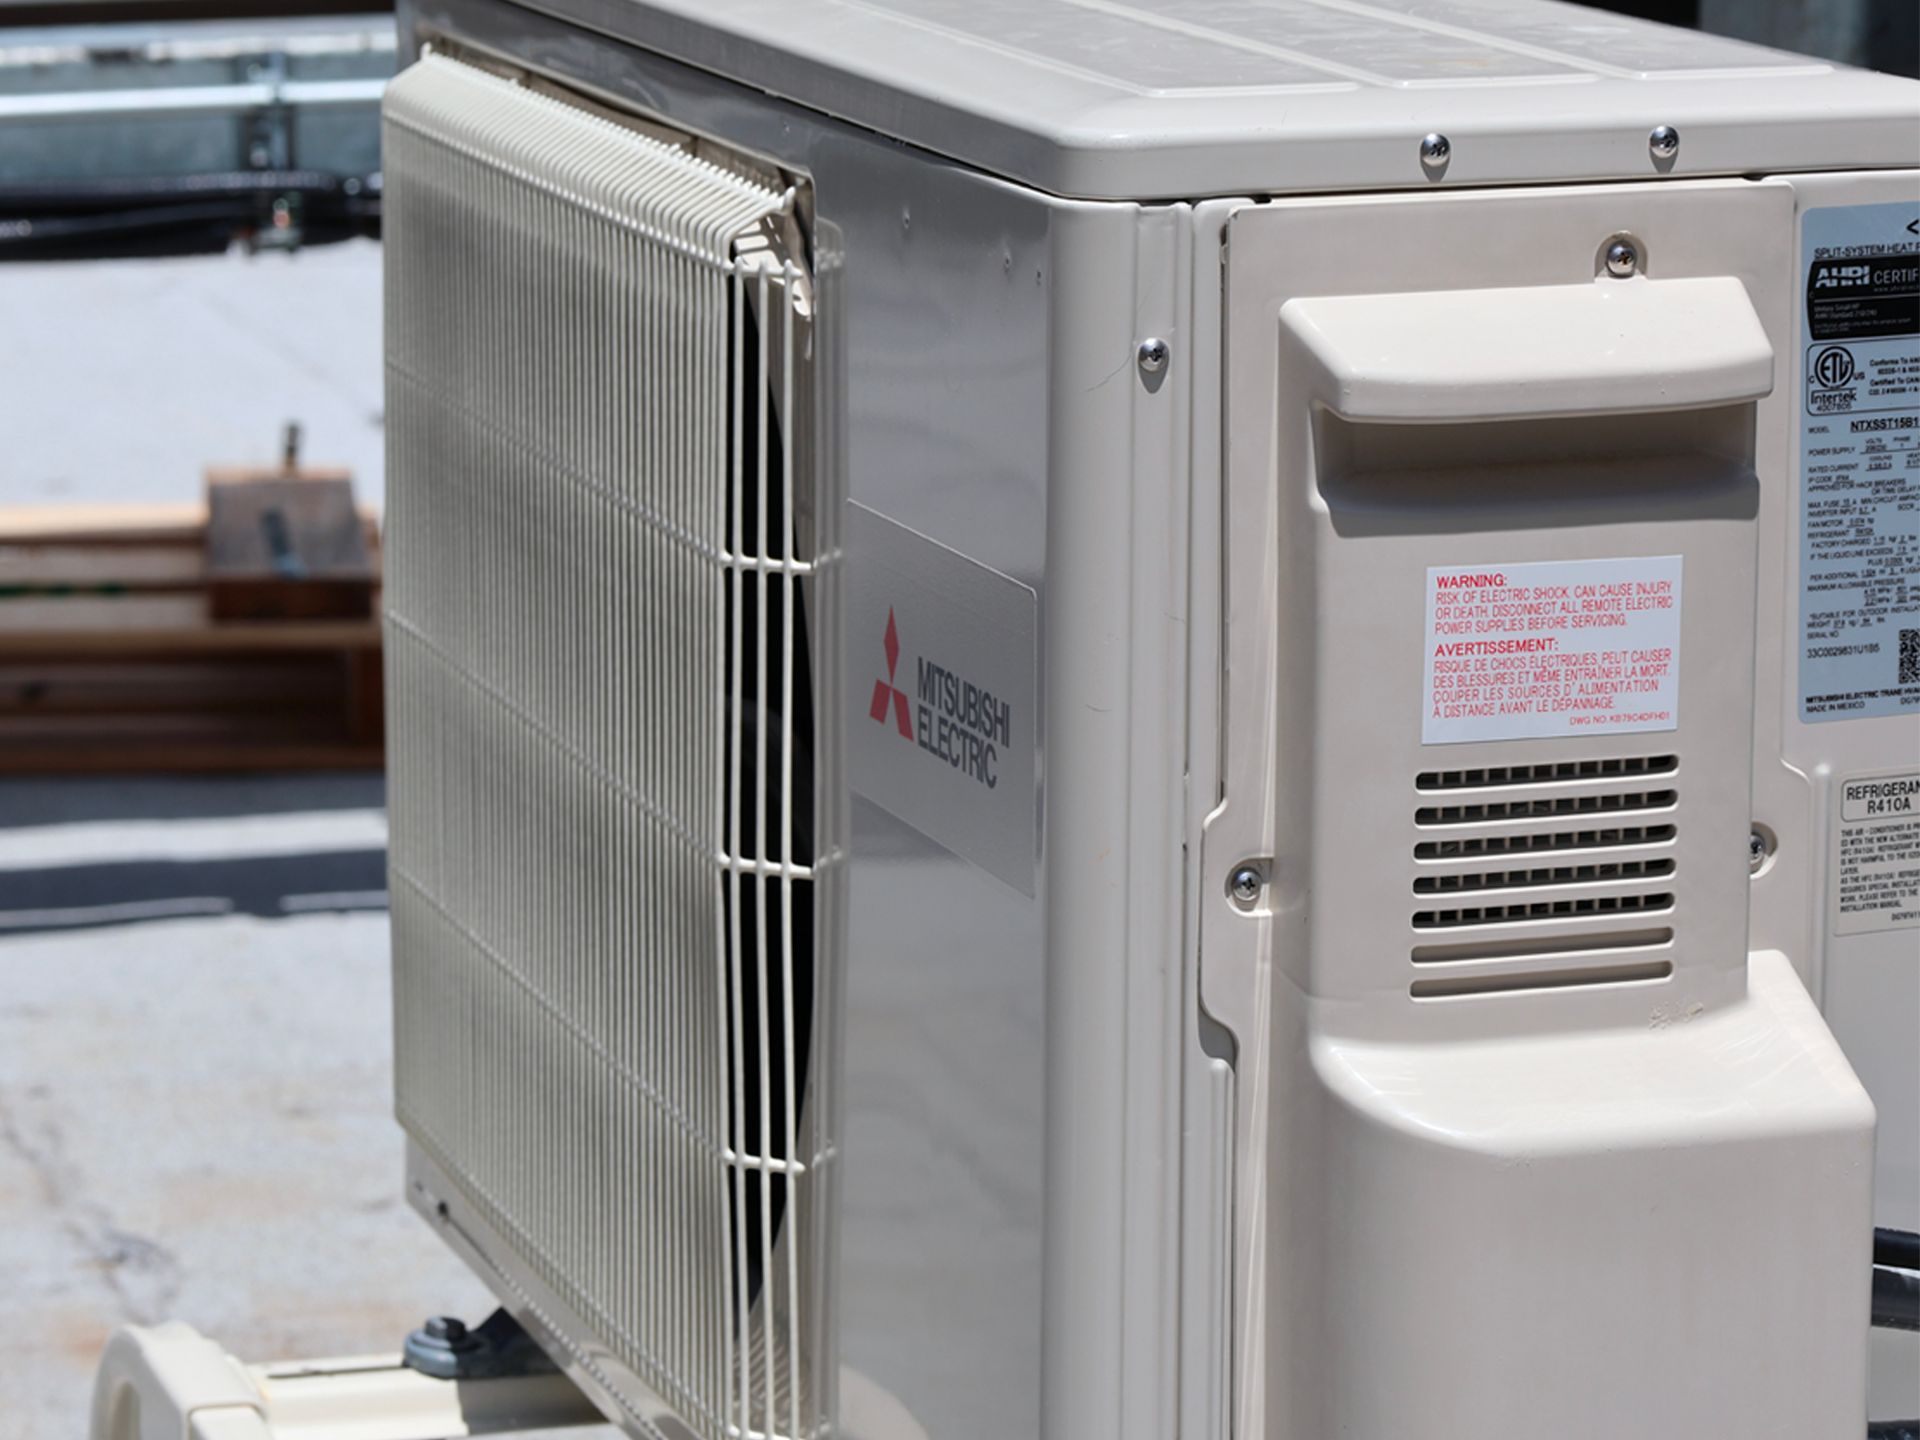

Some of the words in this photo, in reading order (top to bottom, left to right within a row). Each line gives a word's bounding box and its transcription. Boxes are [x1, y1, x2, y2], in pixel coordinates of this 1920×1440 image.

[1814, 244, 1885, 258] SPLIT-SYSTEM
[1887, 242, 1914, 254] HEAT
[1815, 265, 1870, 288] AHRI
[1811, 388, 1857, 404] Intertek
[1436, 572, 1508, 589] WARNING:
[1436, 592, 1460, 605] RISK
[1463, 590, 1477, 604] OF
[1480, 588, 1530, 604] ELECTRIC
[1574, 585, 1596, 599] CAN
[1599, 583, 1633, 597] CAUSE
[1636, 580, 1672, 595] INJURY
[1435, 606, 1451, 620] OR
[1492, 601, 1557, 618] DISCONNECT
[1560, 600, 1579, 614] ALL
[1582, 598, 1622, 613] REMOTE
[1625, 595, 1673, 611] ELECTRIC
[1435, 621, 1473, 635] POWER
[1475, 618, 1525, 633] SUPPLIES
[1528, 615, 1568, 630] BEFORE
[1571, 612, 1627, 629] SERVICING.
[1434, 637, 1559, 657] AVERTISSEMENT:
[1434, 659, 1471, 674] RISQUE
[1475, 658, 1487, 672] DE
[1490, 656, 1526, 671] CHOCS
[1602, 650, 1628, 664] PEUT
[1631, 647, 1671, 663] CAUSER
[1434, 674, 1454, 689] DES
[1457, 671, 1515, 688] BLESSURES
[1518, 670, 1530, 684] ET
[1624, 665, 1638, 679] LA
[918, 655, 1010, 748] MITSUBISHI
[1433, 688, 1480, 704] COUPER
[1483, 687, 1504, 701] LES
[1508, 684, 1560, 699] SOURCES
[1578, 679, 1659, 695] ALIMENTATION
[1443, 702, 1495, 718] DISTANCE
[1499, 700, 1533, 714] AVANT
[1536, 699, 1549, 713] LE
[1806, 704, 1826, 713] MADE
[1837, 701, 1865, 710] MEXICO
[1570, 715, 1591, 726] DWG
[918, 704, 998, 789] ELECTRIC
[1867, 797, 1911, 814] R410A
